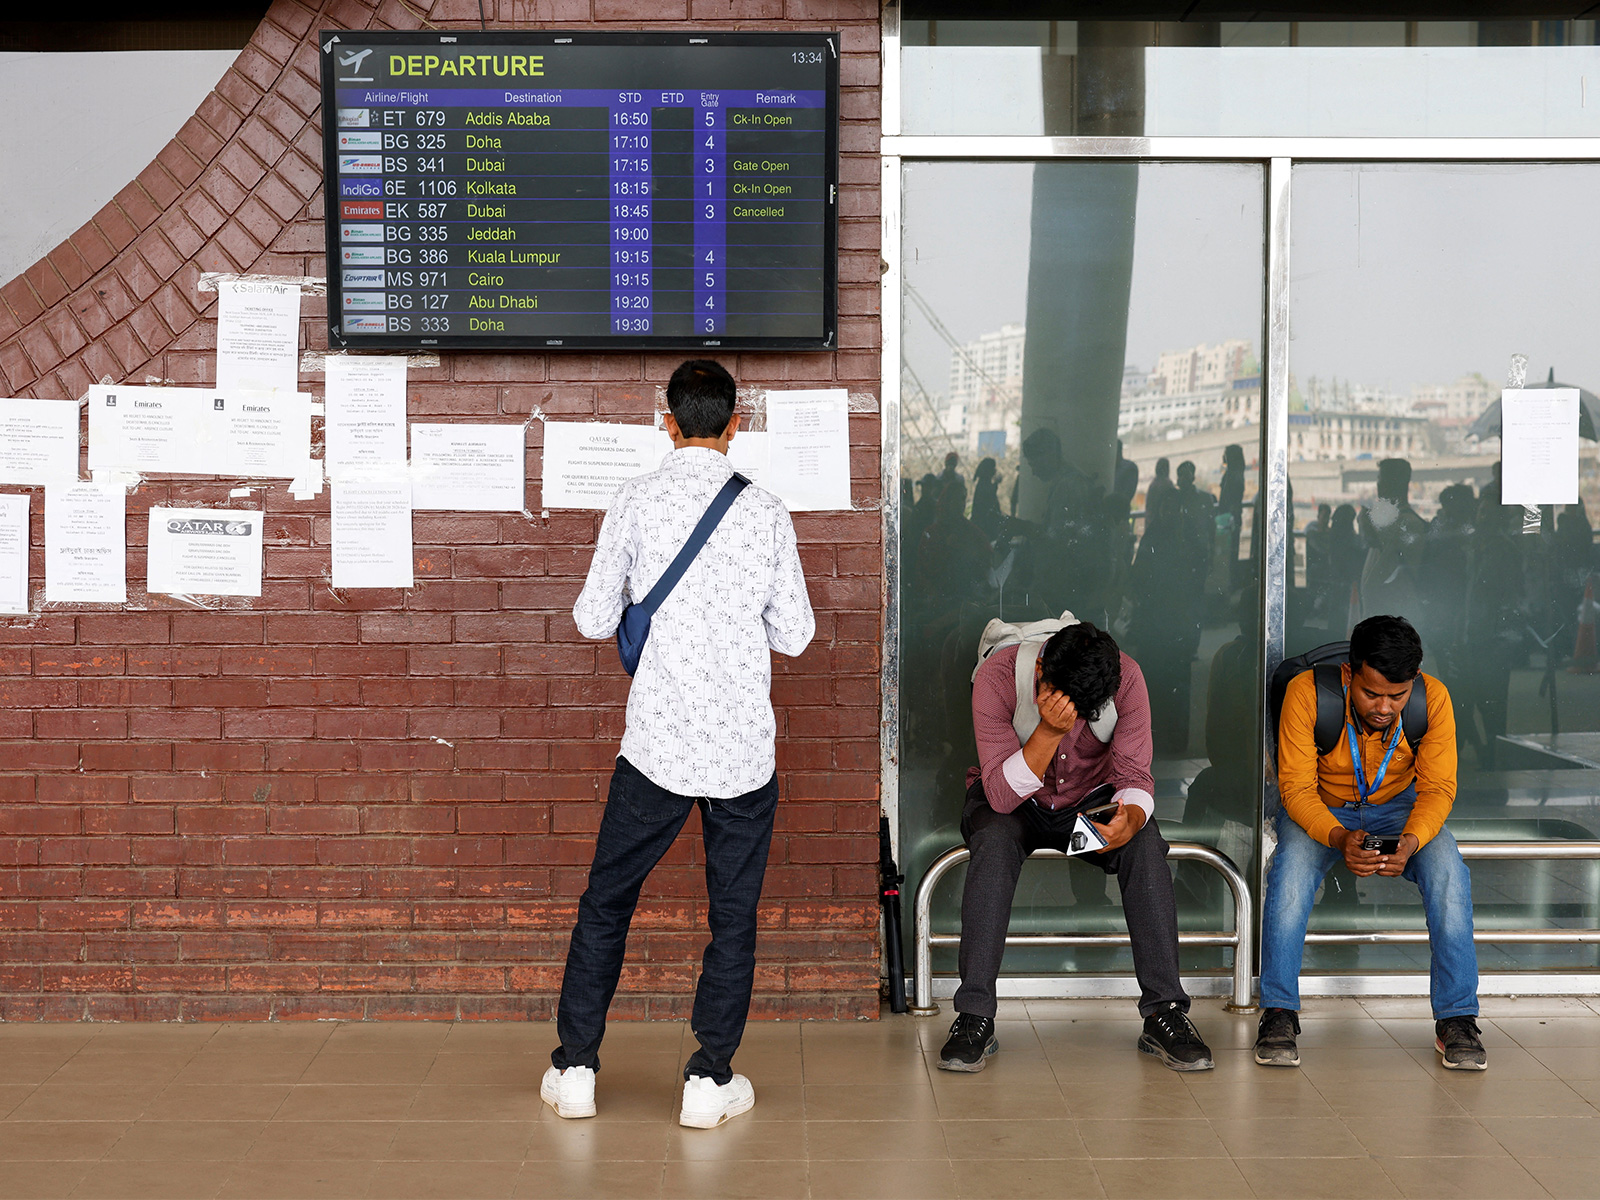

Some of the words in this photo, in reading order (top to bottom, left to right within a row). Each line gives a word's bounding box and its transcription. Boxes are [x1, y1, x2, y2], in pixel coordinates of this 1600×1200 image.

[792, 53, 822, 63] 13:34
[389, 56, 545, 76] DEPARTURE
[364, 92, 429, 104] Airline/Flight
[504, 93, 562, 103] Destination
[619, 94, 642, 102] STD
[662, 94, 684, 103] ETD
[701, 93, 719, 101] Entry
[756, 94, 796, 103] Remark
[384, 112, 405, 126] ET
[416, 111, 446, 126] 679
[465, 112, 503, 125] Addis
[507, 112, 550, 125] Ababa
[613, 113, 648, 125] 16:50
[705, 113, 714, 126] 5
[733, 115, 763, 124] Ck-In
[764, 116, 792, 126] Open
[385, 134, 409, 149] BG
[416, 134, 446, 149] 325
[466, 135, 502, 148] Doha
[613, 136, 648, 148] 17:10
[705, 137, 714, 149] 4
[385, 157, 407, 172] BS
[417, 157, 445, 172] 341
[467, 158, 505, 171] Dubai
[614, 159, 648, 172] 17:15
[705, 160, 714, 172] 3
[733, 161, 758, 171] Gate
[761, 162, 789, 172] Open
[343, 184, 380, 195] IndiGo
[385, 181, 406, 195] 6E
[419, 180, 456, 195] 1106
[467, 182, 516, 194] Kolkata
[614, 182, 648, 194] 18:15
[707, 183, 712, 195] 1
[733, 184, 763, 194] Ck-In
[764, 185, 792, 196] Open
[344, 206, 380, 215] Emirates
[386, 204, 409, 218] EK
[418, 204, 447, 218] 587
[468, 204, 506, 217] Dubai
[614, 205, 648, 218] 18:45
[705, 206, 714, 218] 3
[733, 207, 784, 216] Cancelled
[387, 227, 411, 241] BG
[419, 226, 447, 241] 335
[467, 228, 516, 240] Jeddah
[614, 228, 648, 240] 19:00
[387, 249, 411, 264] BG
[419, 249, 448, 264] 386
[468, 250, 505, 263] Kuala
[510, 250, 560, 266] Lumpur
[614, 251, 649, 263] 19:15
[705, 252, 714, 264] 4
[388, 272, 413, 287] MS
[420, 272, 447, 287] 971
[468, 273, 504, 286] Cairo
[614, 274, 649, 286] 19:15
[705, 274, 714, 286] 5
[240, 284, 288, 294] SalamAir
[388, 295, 413, 309] BG
[421, 295, 449, 309] 127
[469, 296, 495, 308] Abu
[500, 296, 538, 308] Dhabi
[615, 297, 649, 308] 19:20
[705, 297, 714, 309] 4
[389, 317, 411, 331] BS
[421, 317, 449, 331] 333
[470, 318, 504, 331] Doha
[615, 320, 649, 331] 19:30
[705, 320, 714, 332] 3
[135, 400, 162, 408] Emirates
[168, 521, 224, 531] QATAR
